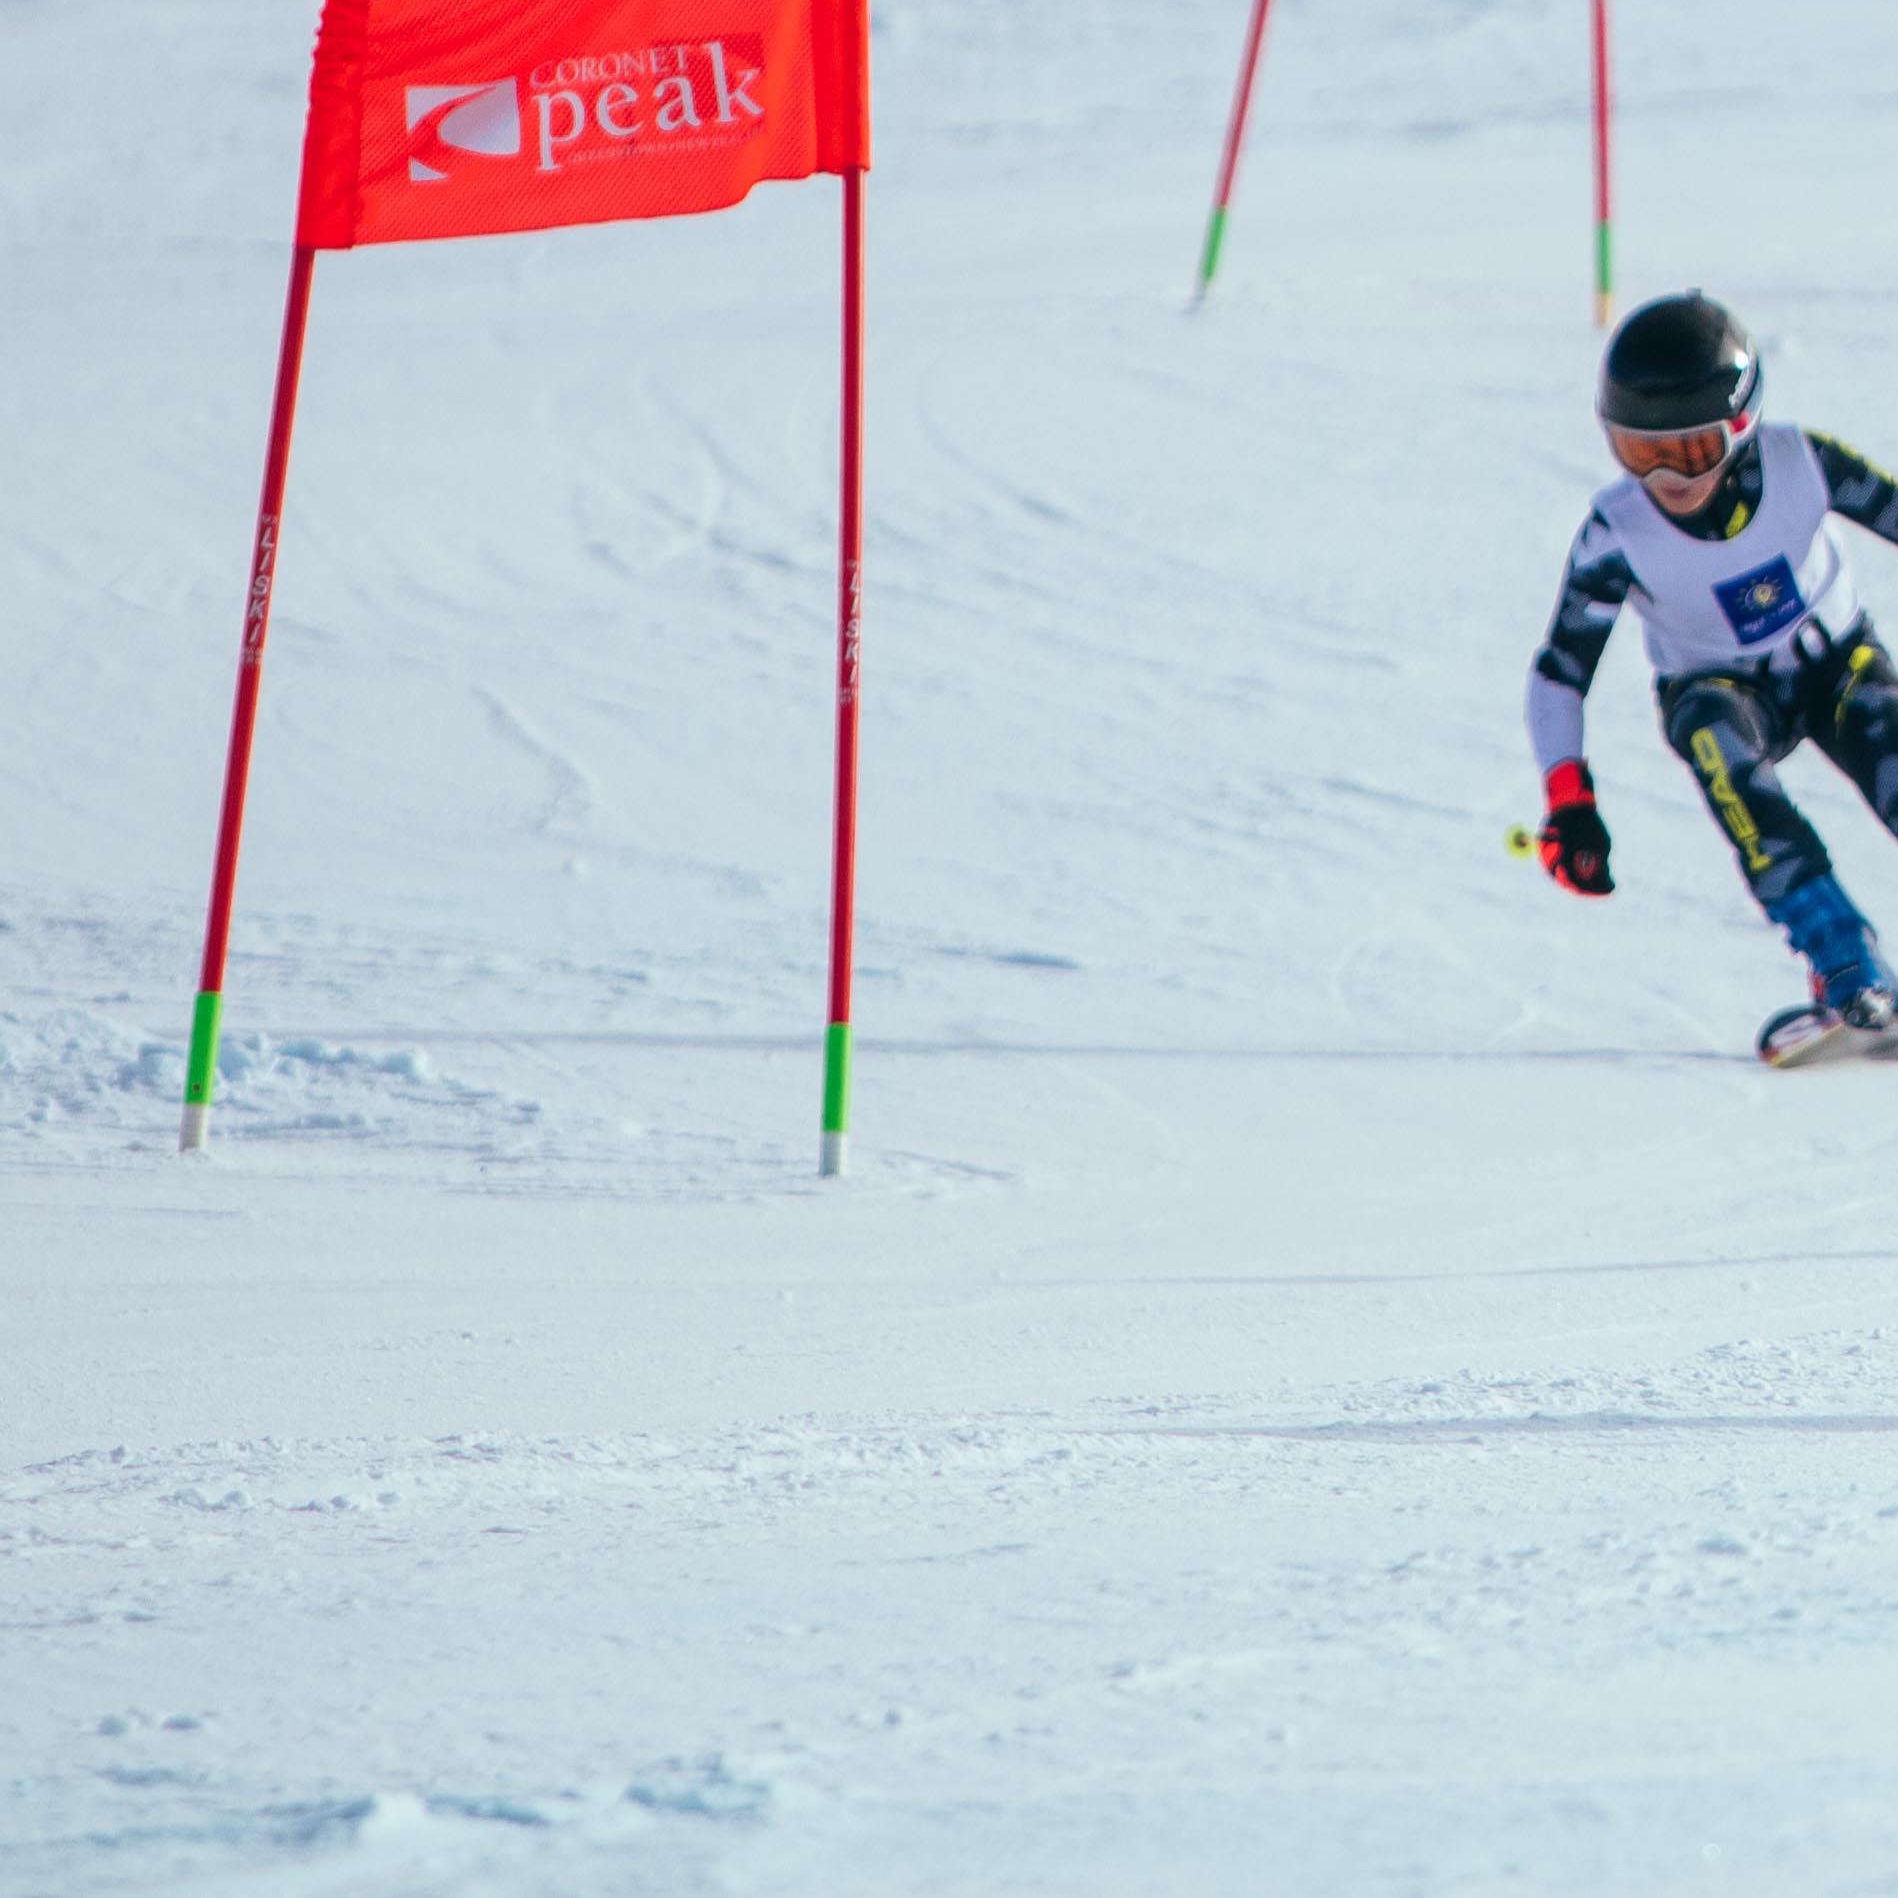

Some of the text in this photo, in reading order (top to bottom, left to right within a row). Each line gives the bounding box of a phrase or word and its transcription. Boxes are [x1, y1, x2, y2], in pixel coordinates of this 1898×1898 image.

[530, 45, 689, 88] CORONET
[531, 41, 765, 171] peak
[247, 526, 275, 644] LISKI
